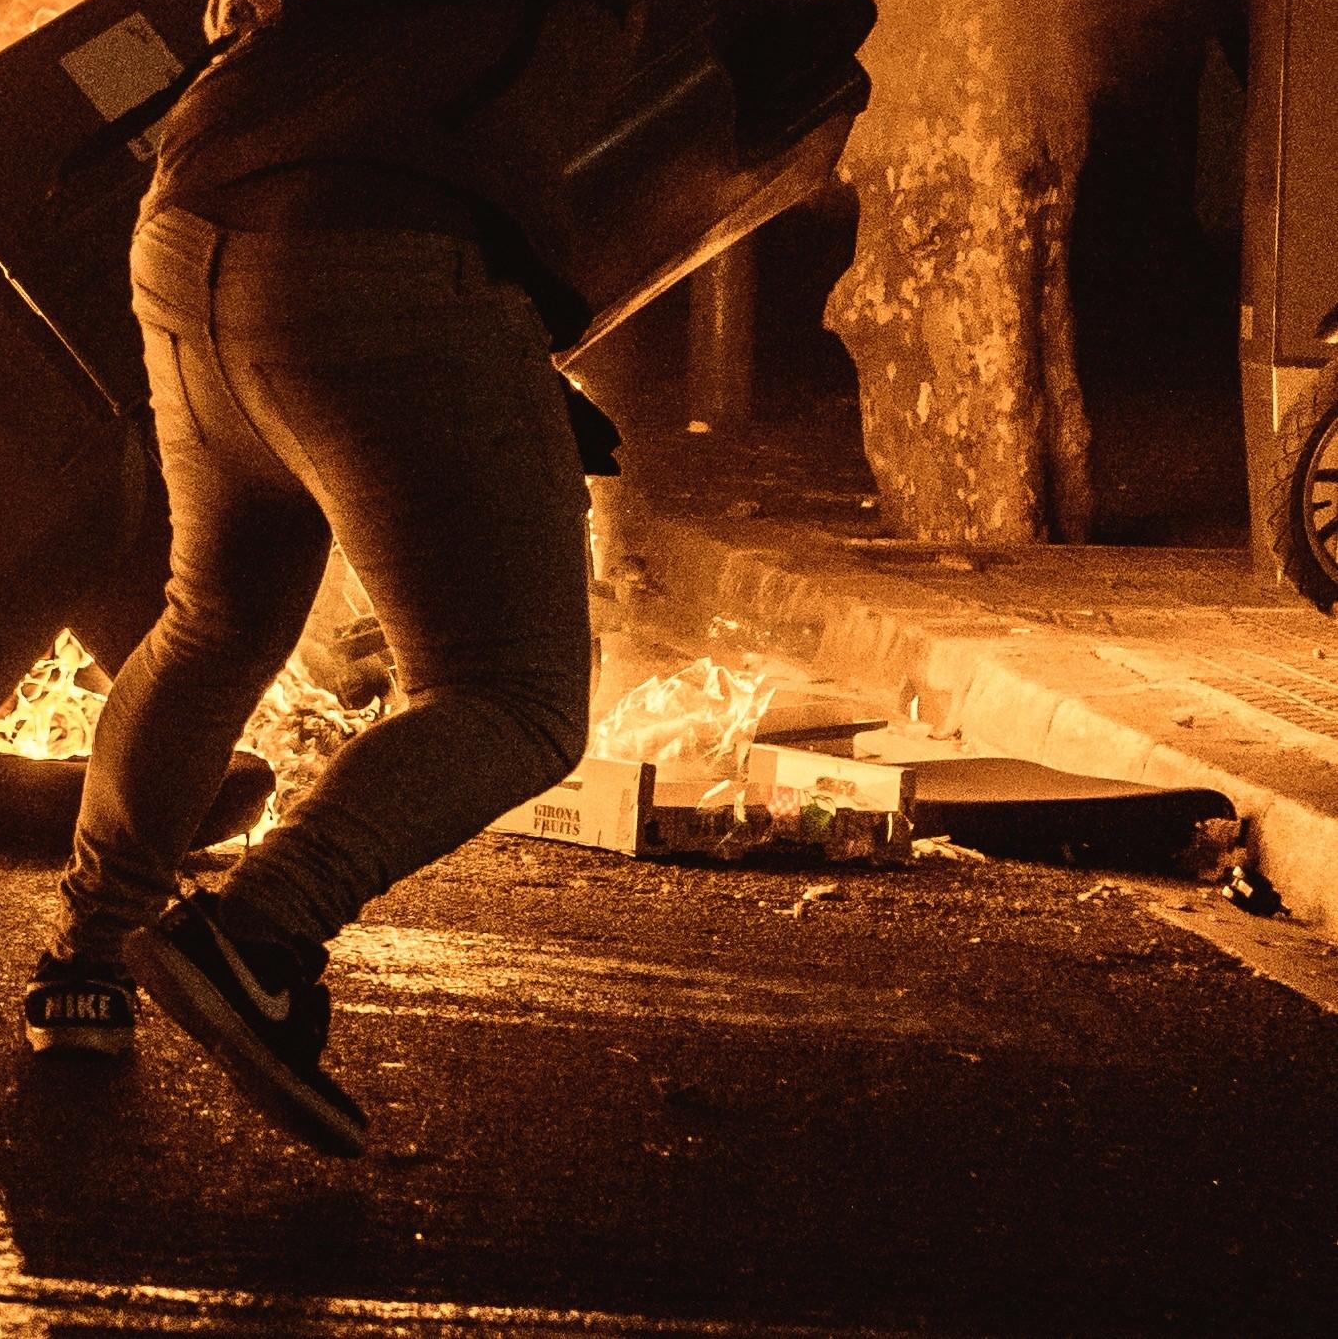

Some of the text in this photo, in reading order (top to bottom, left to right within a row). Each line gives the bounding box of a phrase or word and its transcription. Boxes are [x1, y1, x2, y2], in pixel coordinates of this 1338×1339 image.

[534, 804, 581, 822] GIRONA
[533, 817, 581, 836] FRUITS
[44, 992, 112, 1021] NIKE
